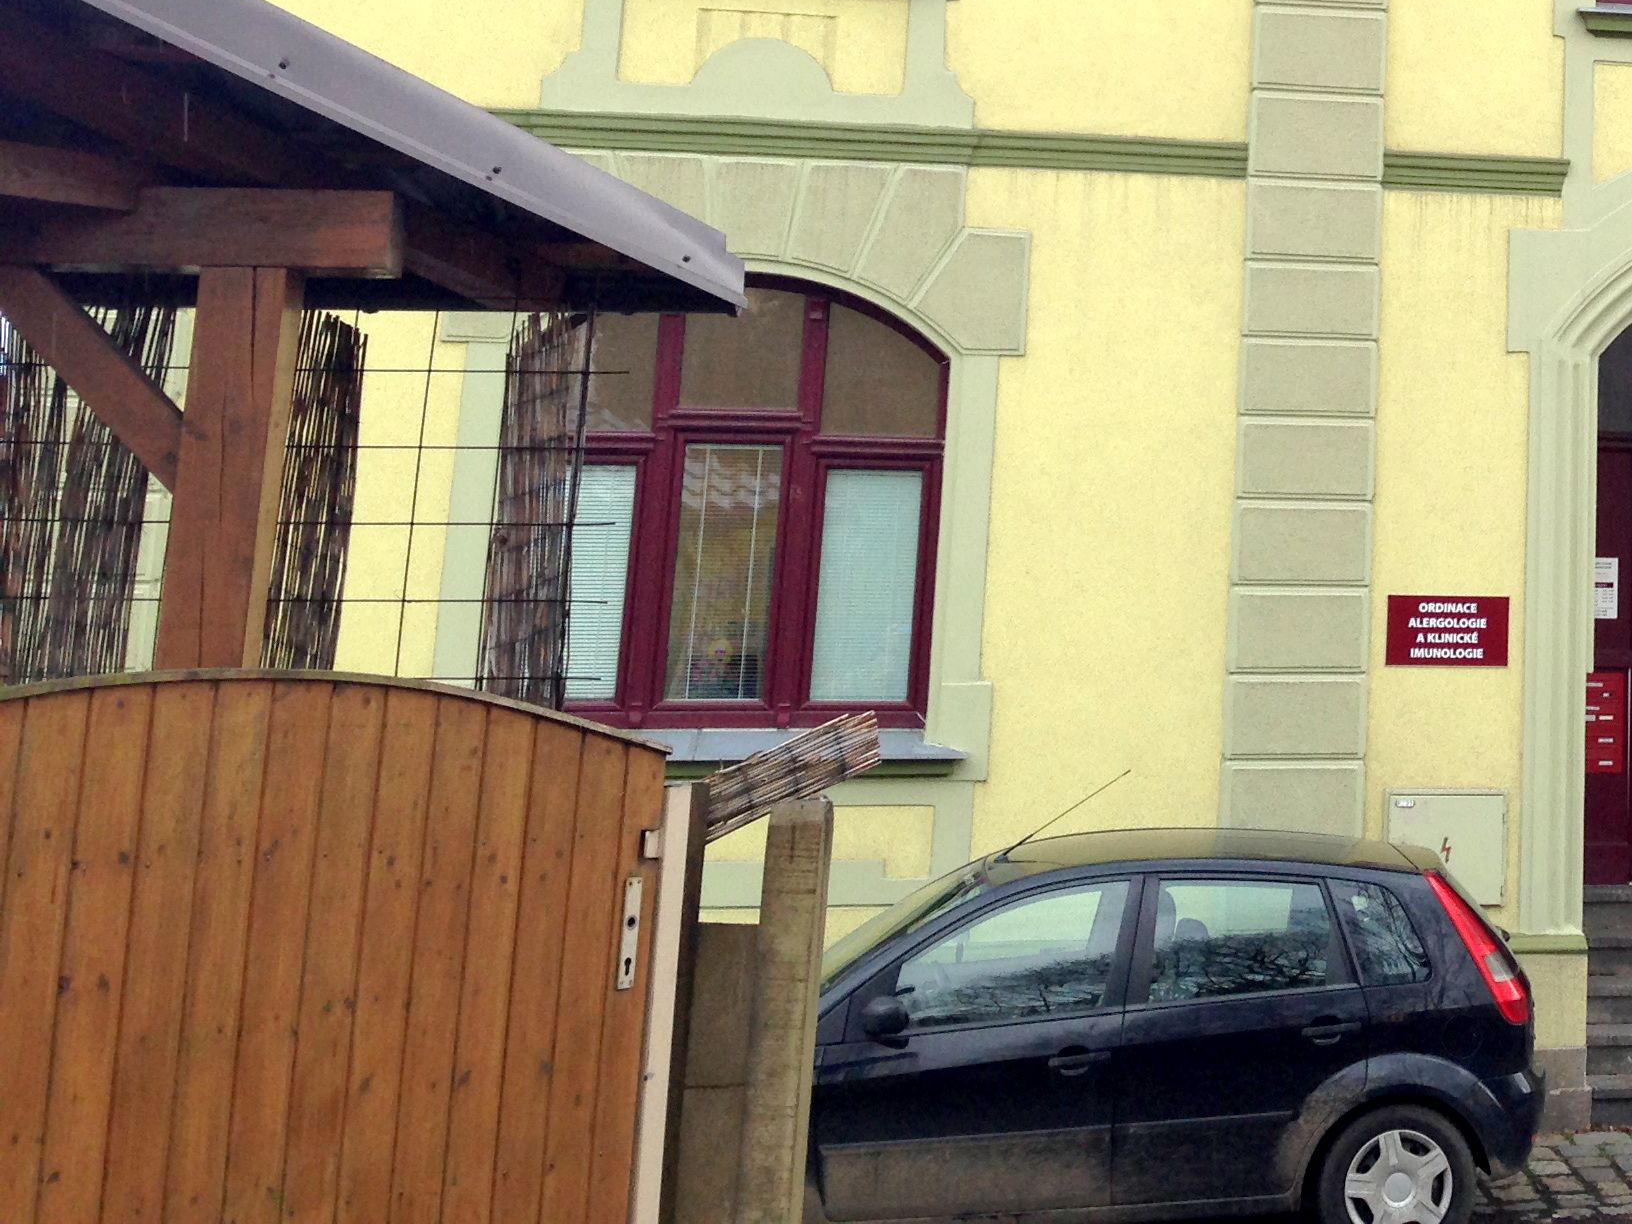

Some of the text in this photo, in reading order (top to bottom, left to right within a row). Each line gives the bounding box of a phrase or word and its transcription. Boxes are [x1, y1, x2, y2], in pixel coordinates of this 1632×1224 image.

[1418, 603, 1478, 613] ORDINACE
[1408, 617, 1487, 628] ALERGOLOGIE
[1416, 631, 1479, 643] A KLINICKÉ
[1410, 647, 1484, 658] IMUNOLOGIE
